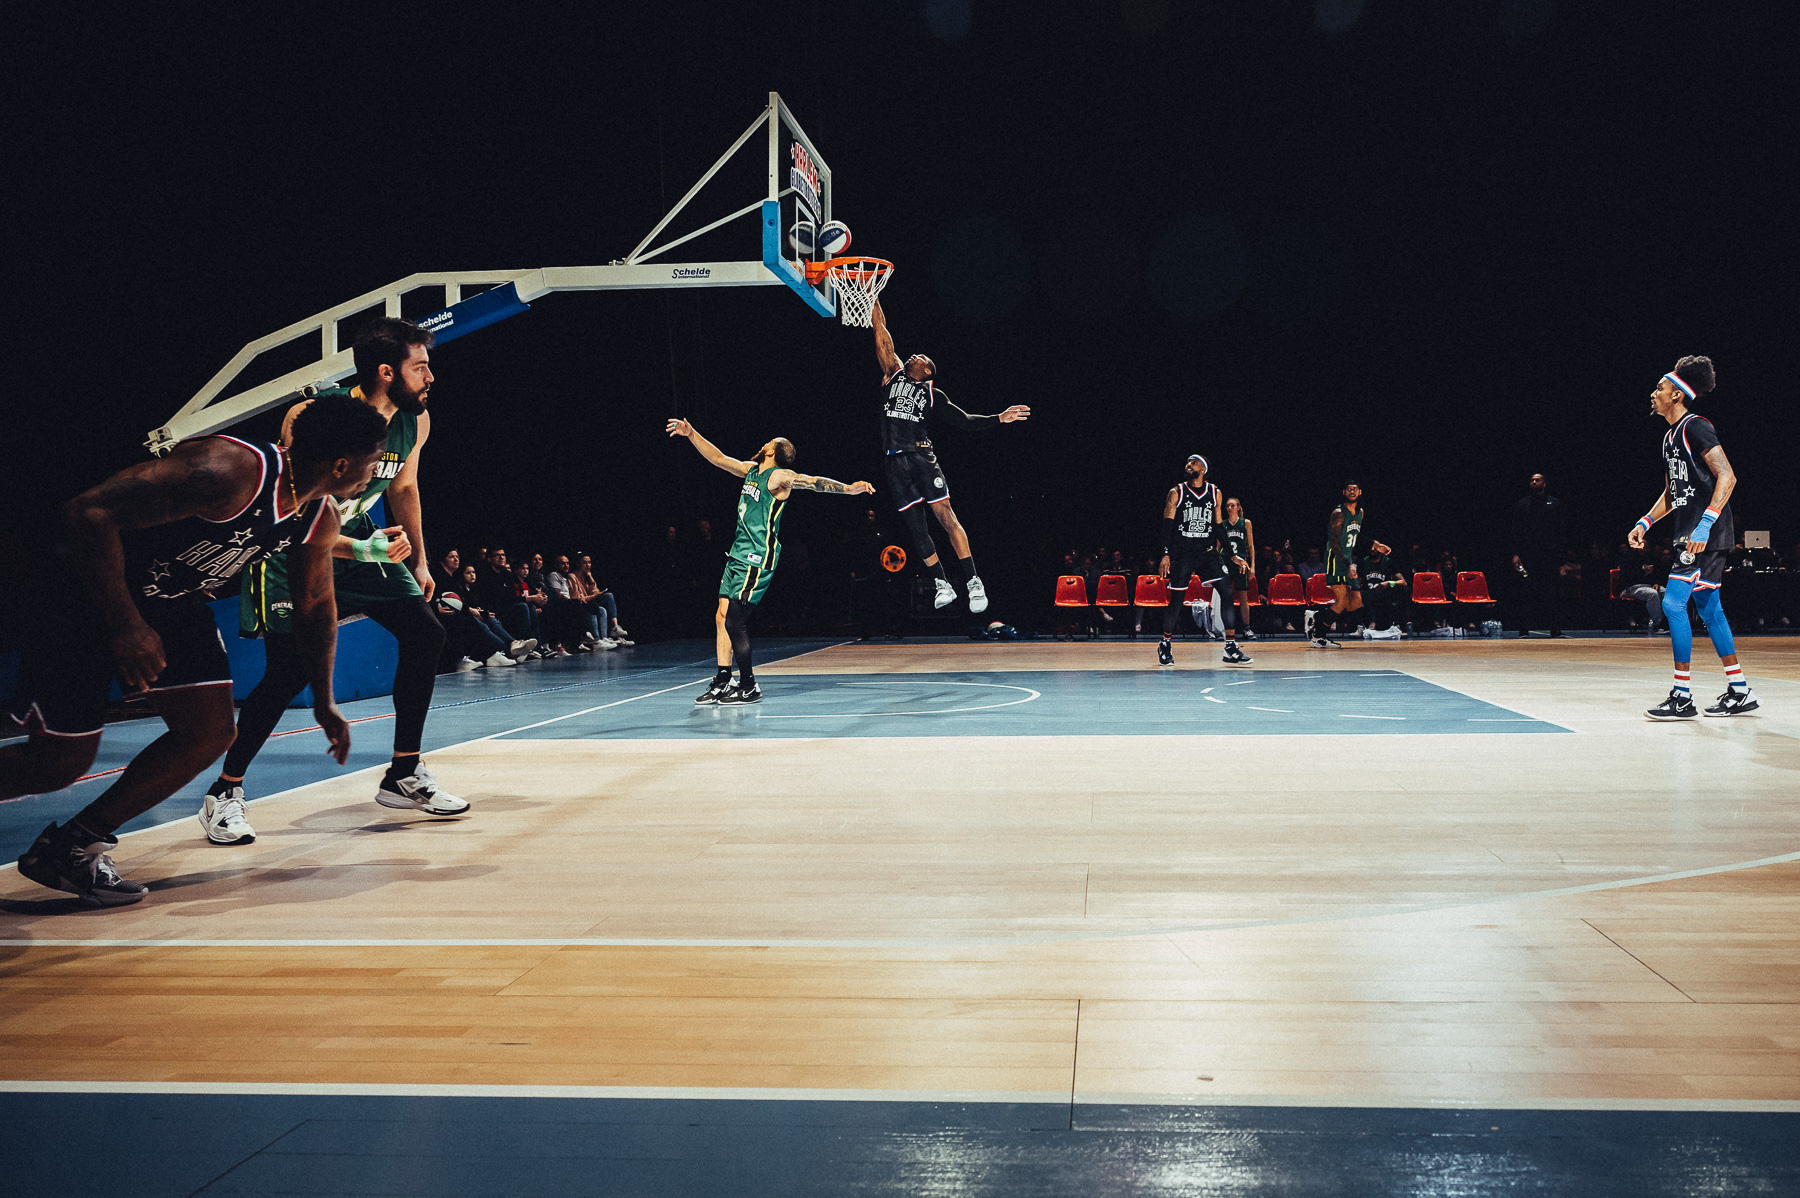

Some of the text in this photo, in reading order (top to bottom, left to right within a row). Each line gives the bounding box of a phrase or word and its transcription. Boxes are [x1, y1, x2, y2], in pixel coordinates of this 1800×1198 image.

[794, 141, 818, 197] HARLEM
[671, 267, 711, 279] Schelde
[894, 396, 915, 414] 23
[1188, 520, 1206, 533] 25
[1346, 533, 1358, 548] 31
